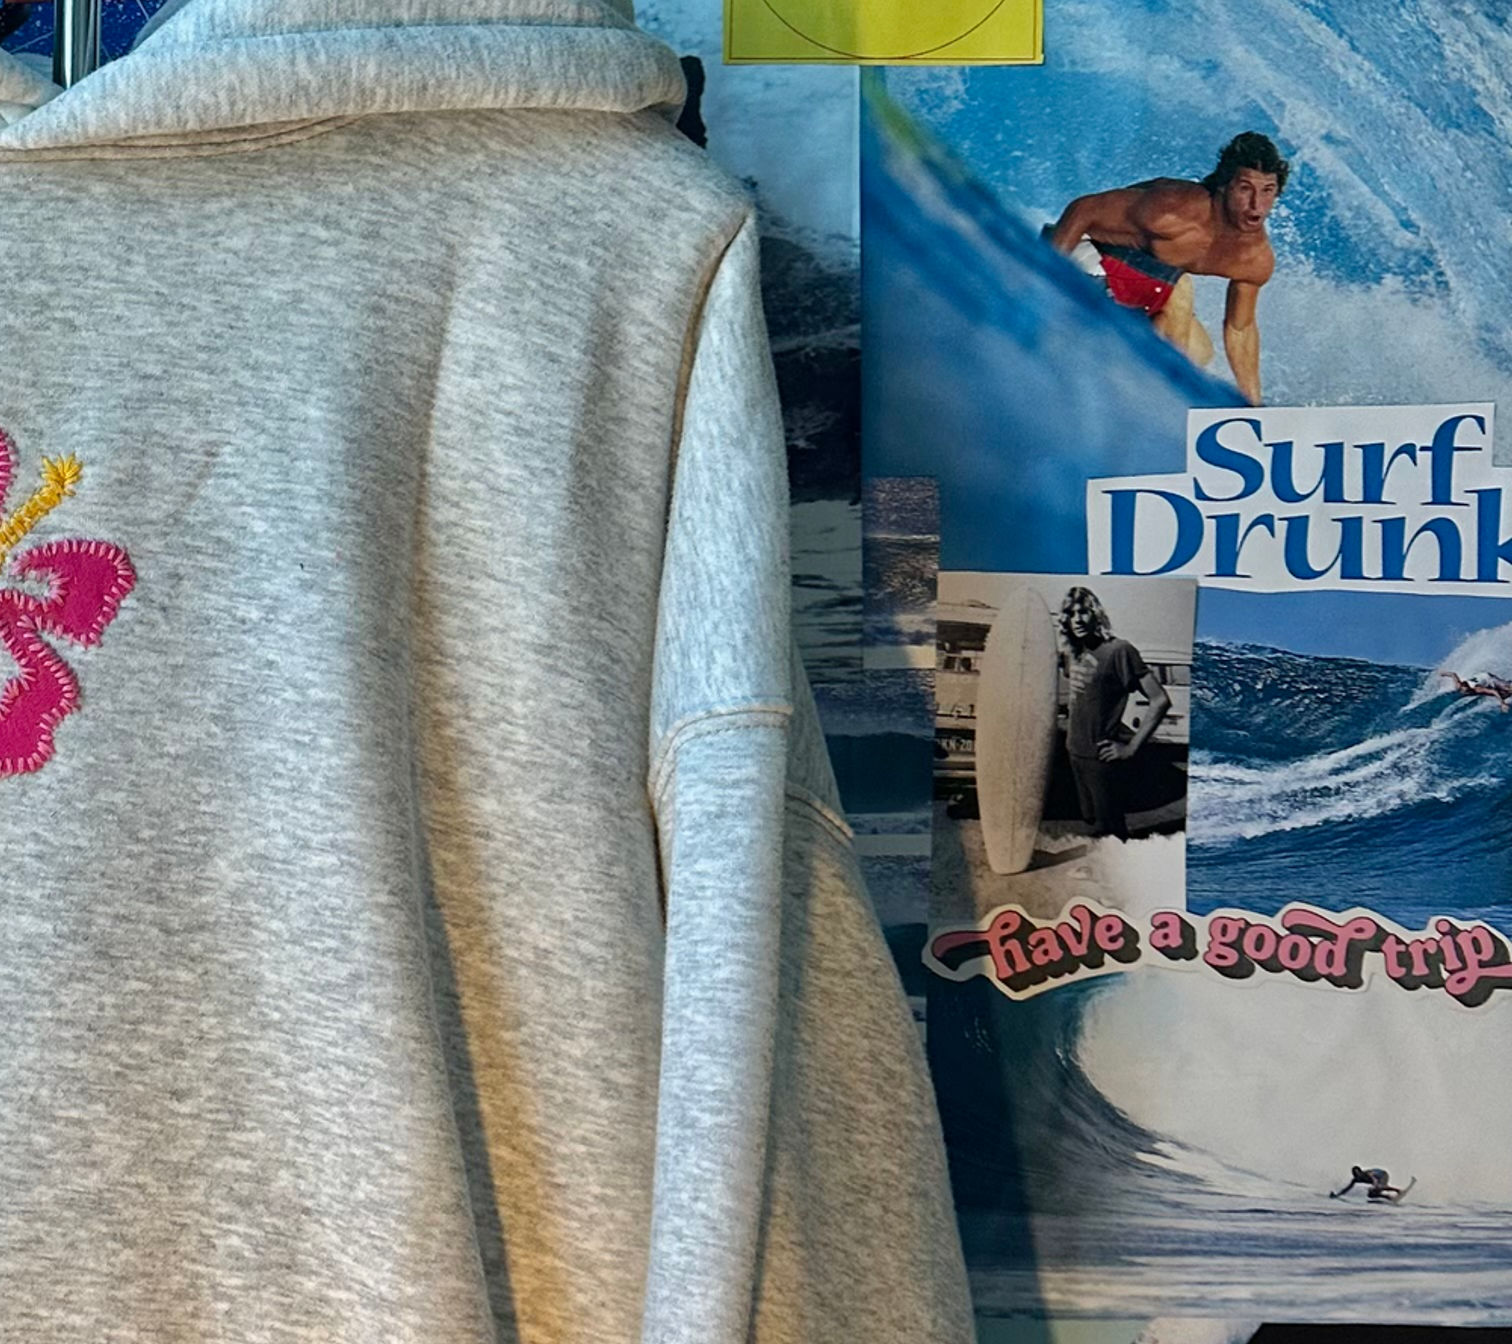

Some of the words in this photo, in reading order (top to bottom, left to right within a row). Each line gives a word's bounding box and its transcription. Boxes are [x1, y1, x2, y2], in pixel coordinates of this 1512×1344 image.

[1192, 414, 1486, 507] Surf
[1100, 487, 1512, 583] Drunk
[932, 903, 1133, 982] have
[1149, 911, 1191, 958] a
[1203, 905, 1378, 982] good
[1381, 918, 1512, 1000] trip
